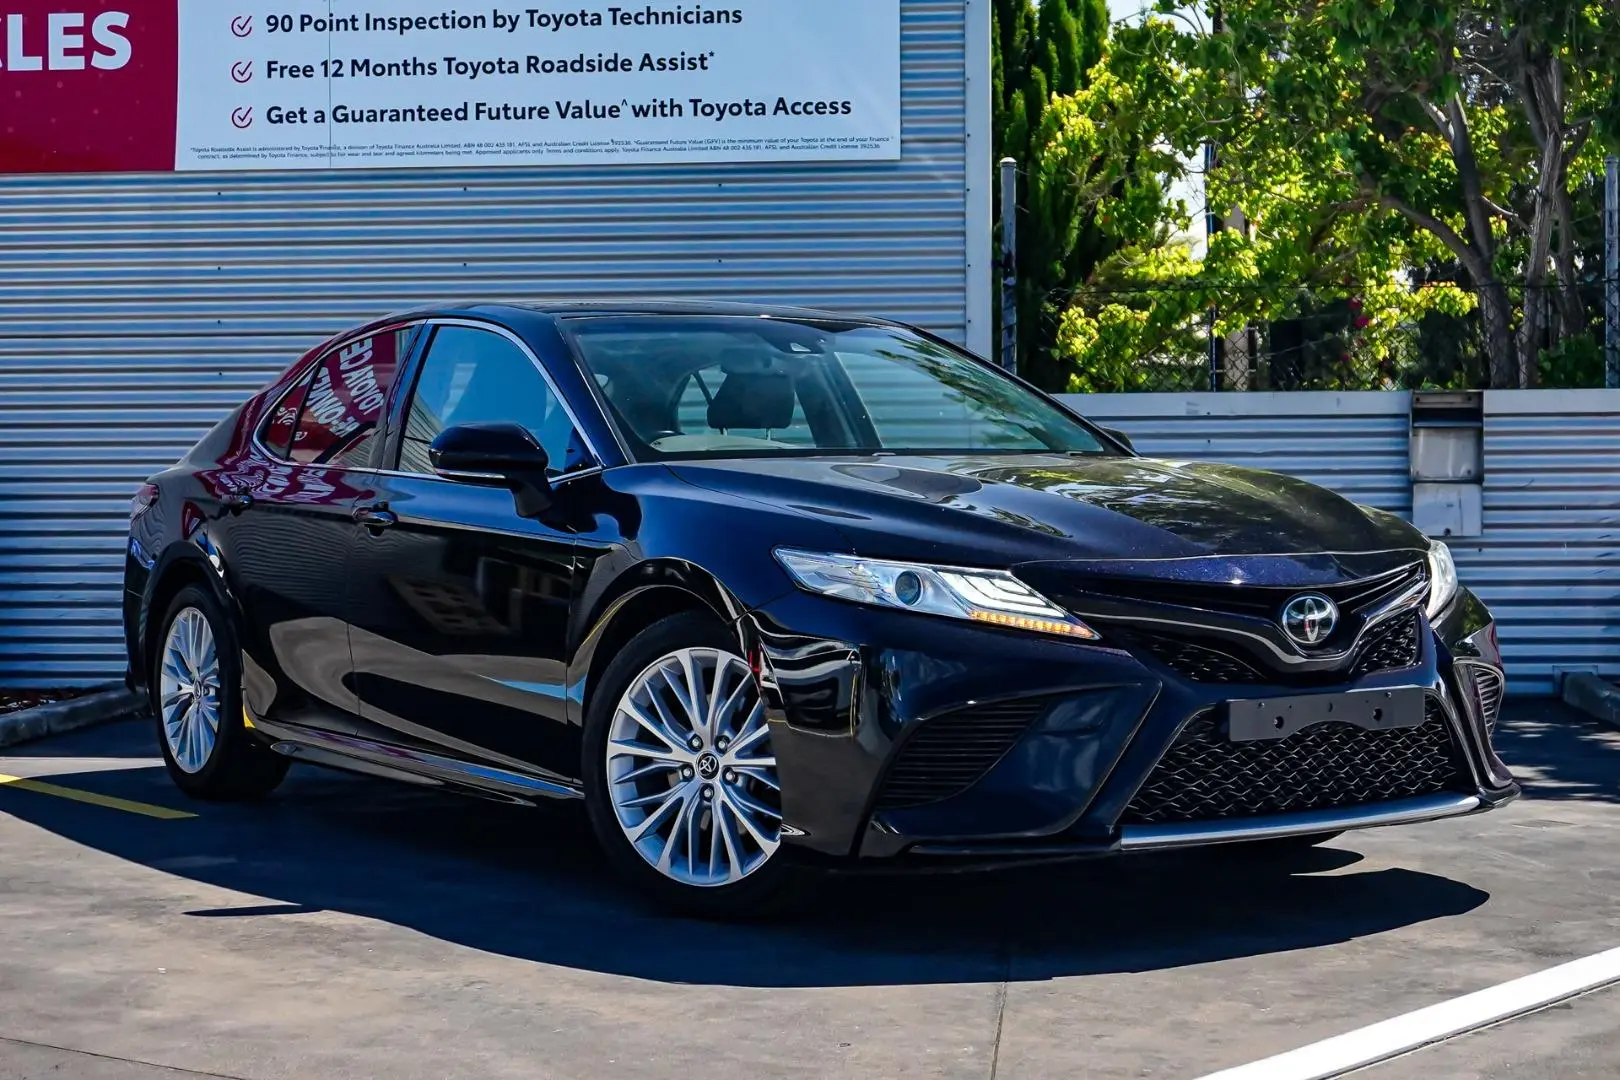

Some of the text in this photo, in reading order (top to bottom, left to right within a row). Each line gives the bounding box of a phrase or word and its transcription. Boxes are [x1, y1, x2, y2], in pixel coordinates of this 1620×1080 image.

[265, 4, 744, 36] 90 Point Inspection by Toyota Technicians
[0, 11, 133, 72] LES
[266, 60, 316, 79] Free
[320, 59, 345, 78] 12
[350, 56, 438, 78] Months
[442, 56, 520, 80] Toyota
[526, 52, 633, 74] Roadside
[266, 105, 308, 125] Get
[313, 109, 326, 124] a
[331, 101, 469, 124] Guaranteed
[475, 102, 550, 121] Future
[631, 97, 683, 118] with
[688, 98, 767, 122] Toyota
[772, 96, 852, 116] Access
